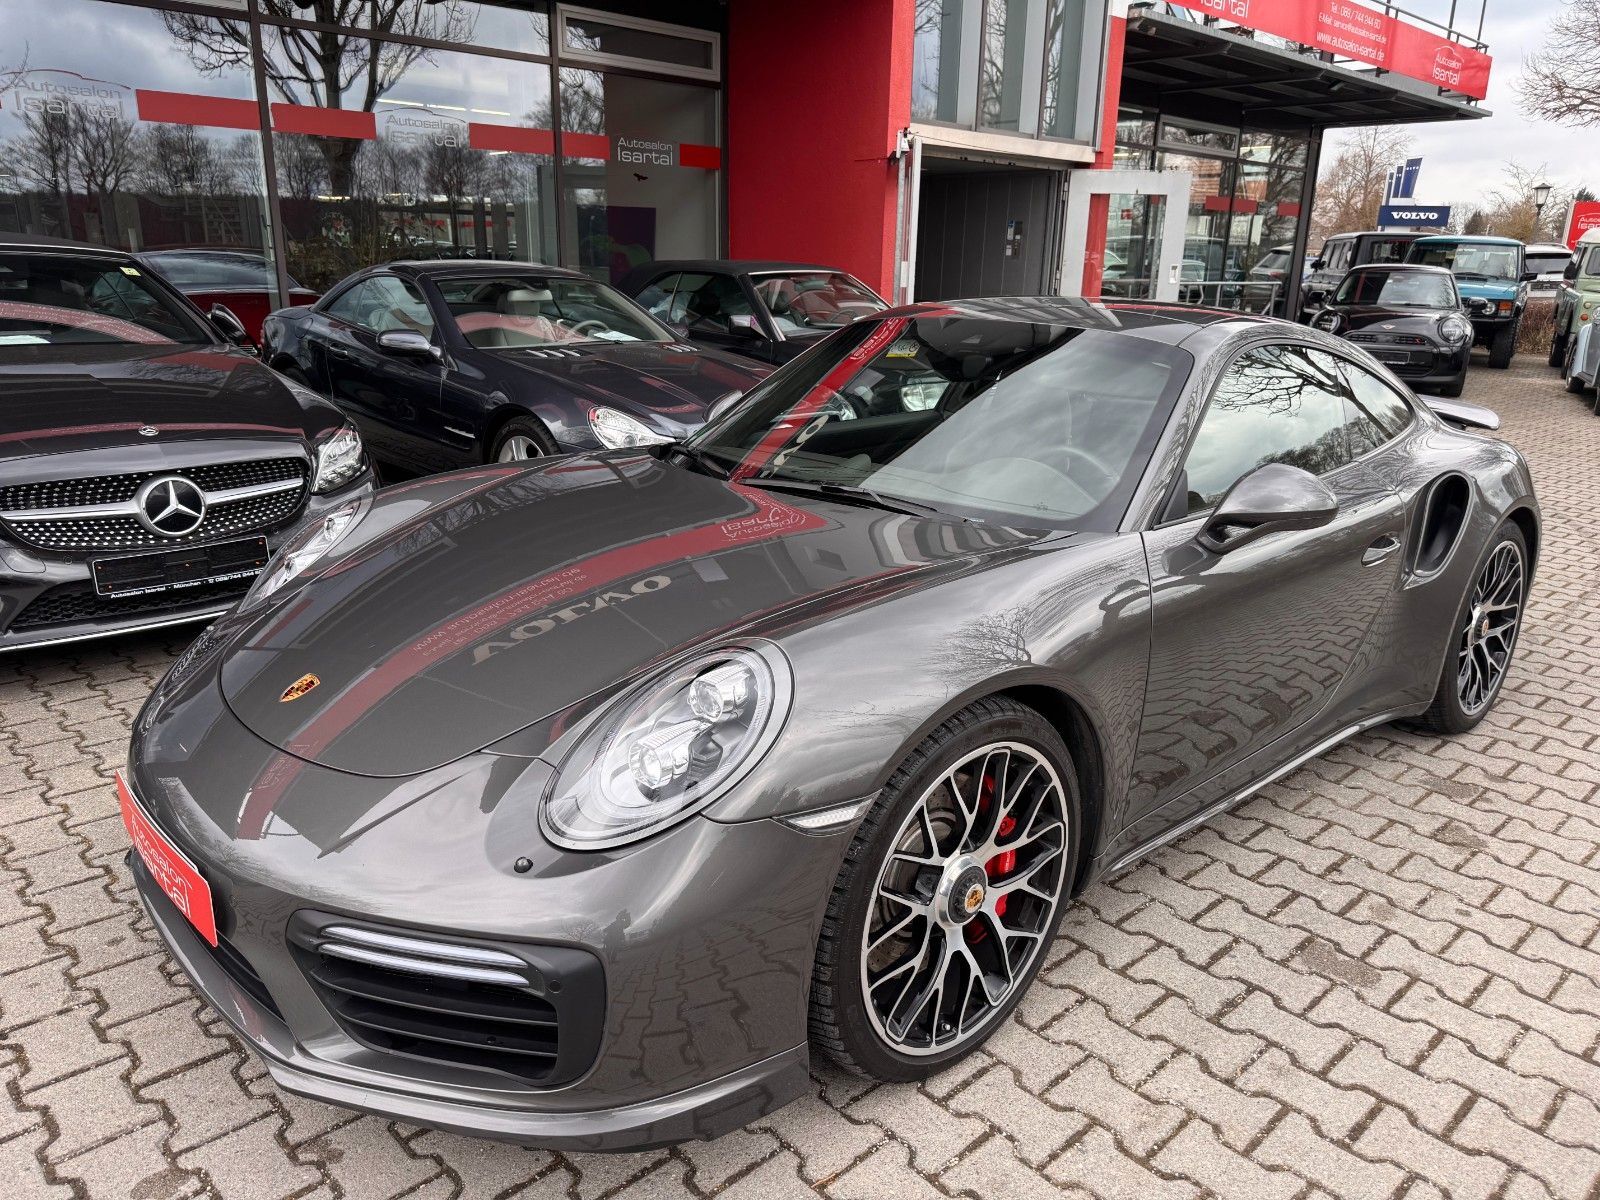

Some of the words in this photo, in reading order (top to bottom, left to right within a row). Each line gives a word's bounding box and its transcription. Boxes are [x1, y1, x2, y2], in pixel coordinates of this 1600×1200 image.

[1200, 0, 1250, 18] artal
[1436, 52, 1462, 70] Autosalon
[1432, 61, 1460, 87] Isartal
[15, 77, 122, 99] Autosalon
[15, 90, 124, 120] Isartal
[386, 114, 460, 130] Autosalon
[618, 137, 673, 151] Autosalon
[617, 147, 673, 166] Isartal
[1391, 211, 1439, 220] VOLVO
[110, 590, 144, 599] Autosalon
[145, 586, 167, 594] Isartal
[173, 581, 202, 589] München
[131, 813, 187, 888] Autosalon
